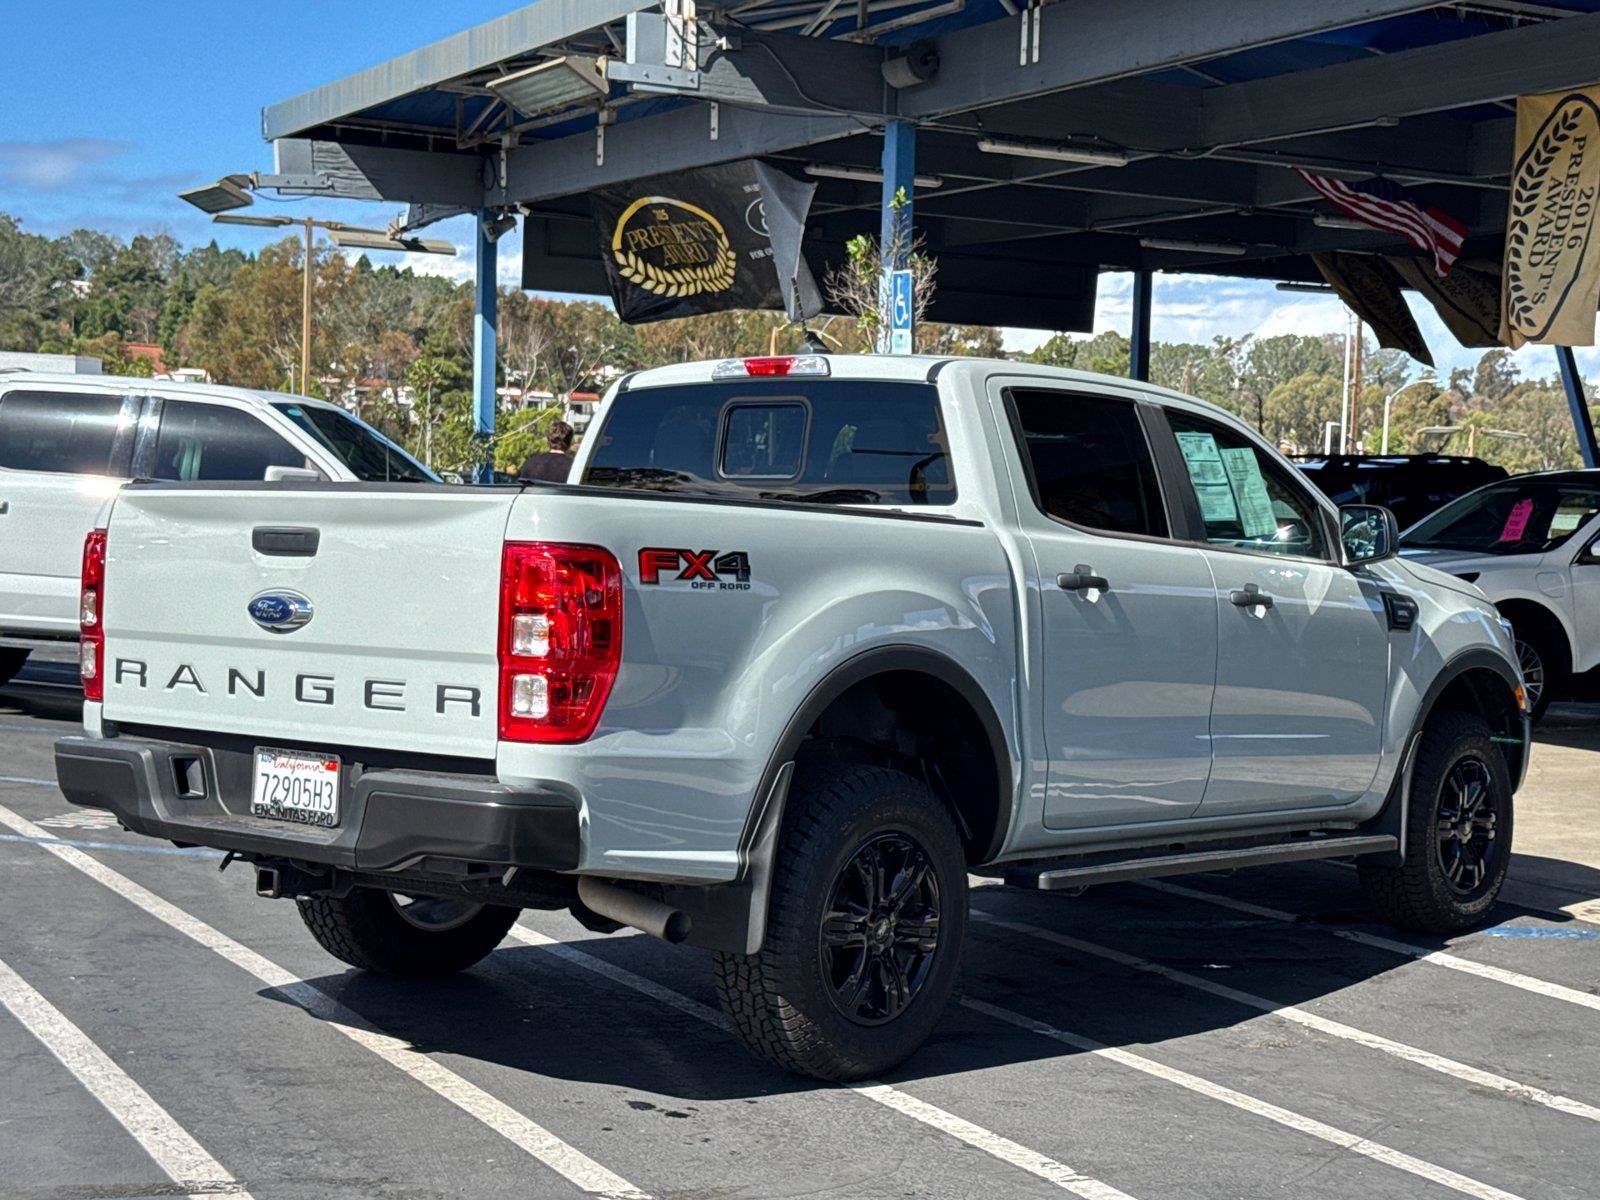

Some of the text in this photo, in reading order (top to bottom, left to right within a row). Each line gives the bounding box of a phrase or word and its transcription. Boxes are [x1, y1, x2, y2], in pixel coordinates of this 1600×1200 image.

[1527, 176, 1564, 268] AWARD
[1531, 135, 1588, 305] PRESIDENT'S
[1566, 186, 1595, 250] 2016
[664, 242, 709, 266] AWRD
[638, 547, 751, 585] FX4
[691, 581, 751, 590] OFF ROAD
[115, 658, 481, 717] RANGER
[273, 754, 320, 775] California
[261, 773, 334, 810] 72905H3
[308, 811, 334, 825] FORD
